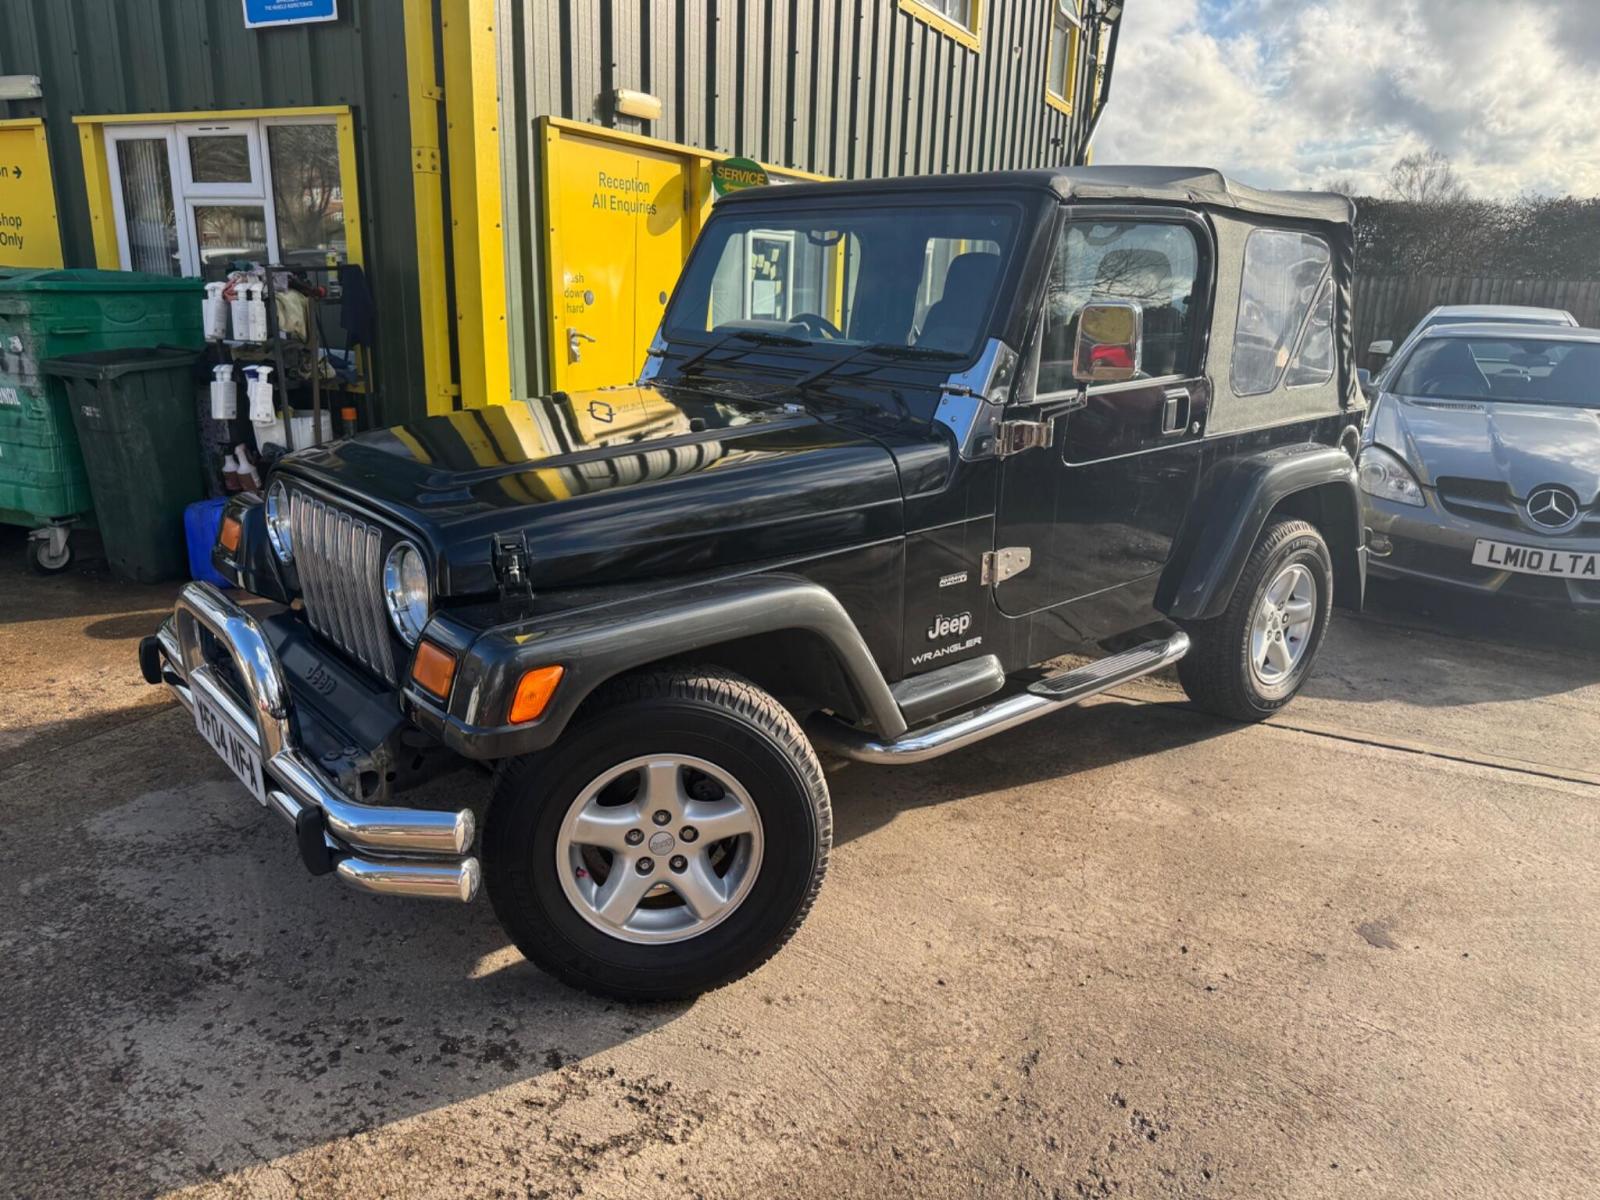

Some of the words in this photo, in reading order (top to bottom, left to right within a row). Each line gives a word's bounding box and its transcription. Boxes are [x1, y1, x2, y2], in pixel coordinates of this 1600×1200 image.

[598, 171, 650, 195] Reception
[716, 166, 765, 185] SERVICE
[592, 193, 607, 209] All
[610, 195, 657, 216] Enquiries
[0, 231, 24, 250] Only
[566, 302, 585, 313] hard
[1487, 543, 1544, 570] LM10
[1549, 553, 1596, 575] LTA
[928, 613, 971, 639] Jeep
[911, 636, 982, 665] WRANGLER
[305, 662, 337, 696] Jeep
[228, 731, 259, 793] NFA
